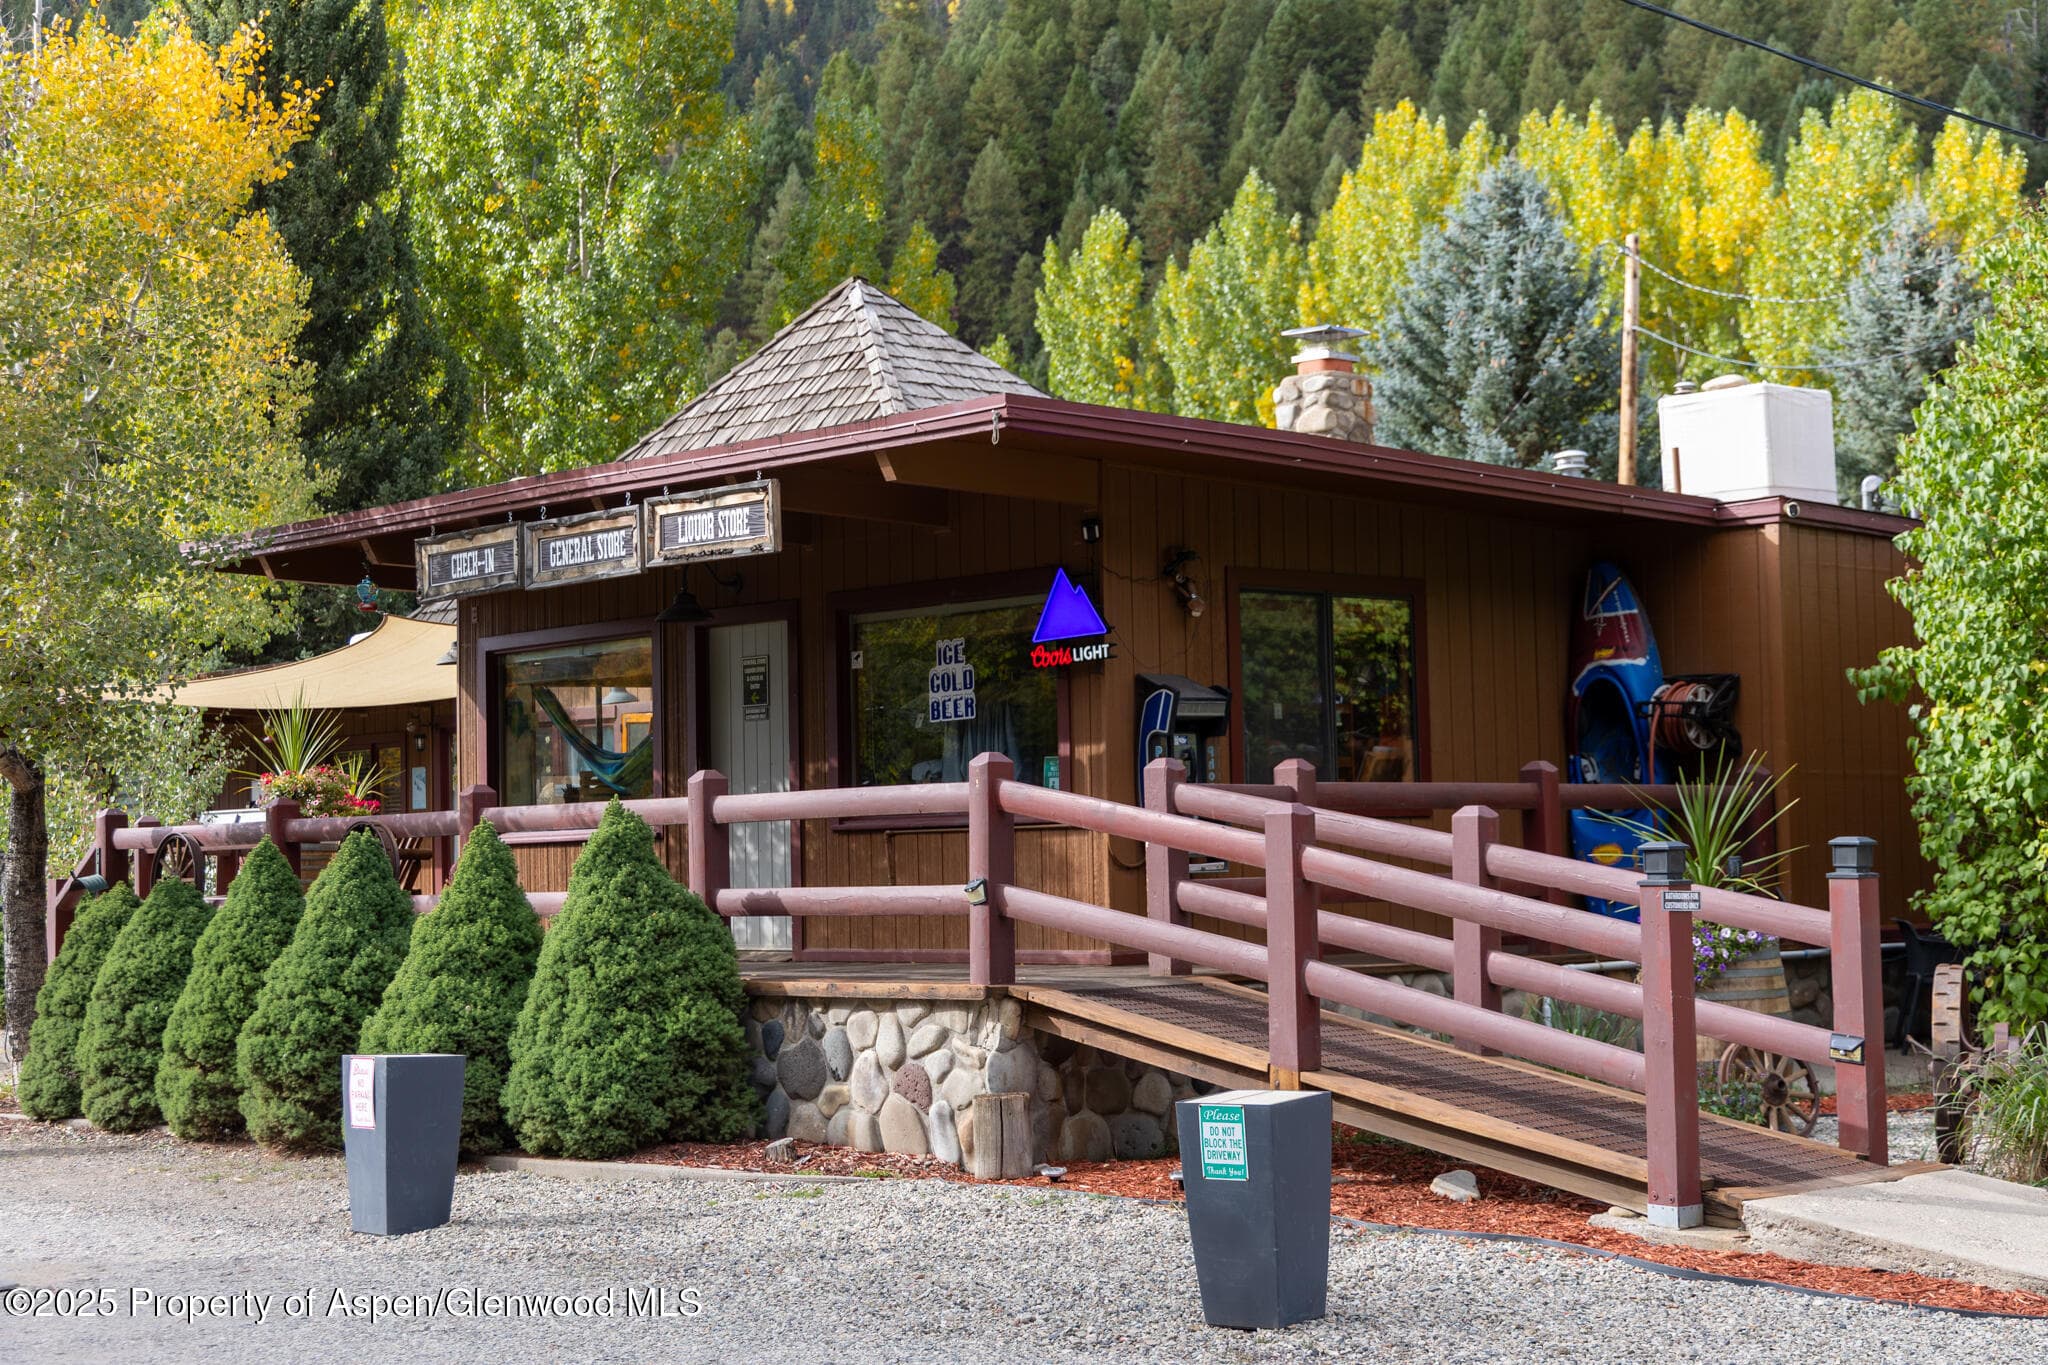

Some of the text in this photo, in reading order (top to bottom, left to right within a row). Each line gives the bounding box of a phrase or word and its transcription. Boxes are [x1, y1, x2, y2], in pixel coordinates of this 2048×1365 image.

[678, 507, 750, 543] LIQUOR STORE
[549, 536, 595, 567] GENERAL
[597, 529, 626, 560] STORE
[451, 548, 495, 579] CHECK-IN
[937, 640, 965, 666] ICE
[1030, 643, 1110, 668] Coors LIGHT
[930, 668, 974, 693] COLD
[930, 696, 975, 720] BEER
[1204, 1109, 1240, 1120] Please
[1209, 1126, 1235, 1136] DO NOT
[1204, 1138, 1243, 1149] BLOCK THE
[1207, 1150, 1241, 1160] DRIVEWAY
[1206, 1166, 1245, 1177] Thank You!
